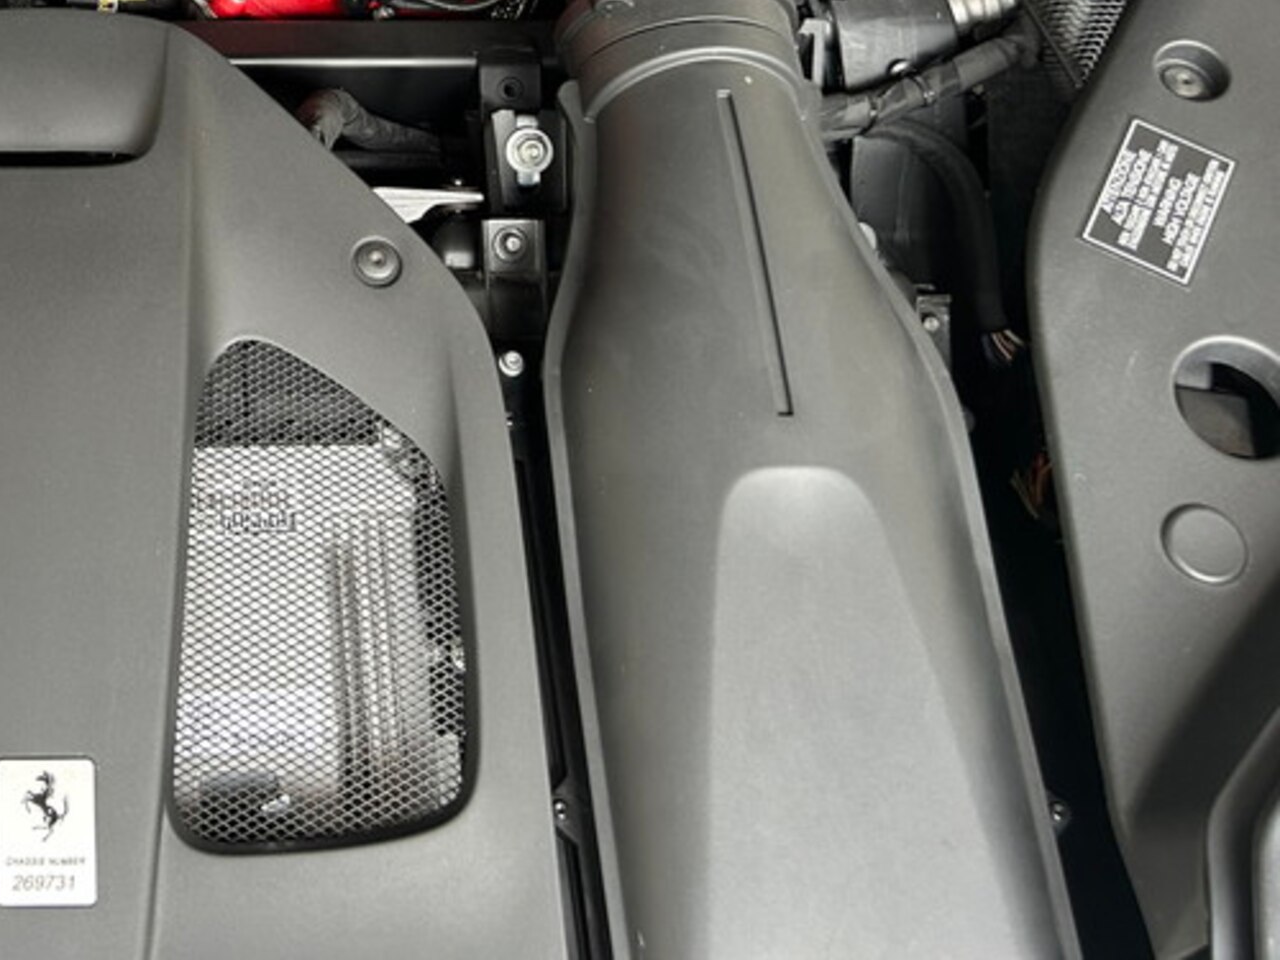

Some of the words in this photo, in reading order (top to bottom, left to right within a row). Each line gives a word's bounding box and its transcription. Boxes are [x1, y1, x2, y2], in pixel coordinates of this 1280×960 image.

[1152, 176, 1184, 228] WARNING
[6, 856, 45, 867] CHASSIS
[48, 856, 86, 867] NUMBER
[12, 874, 76, 892] 269731
